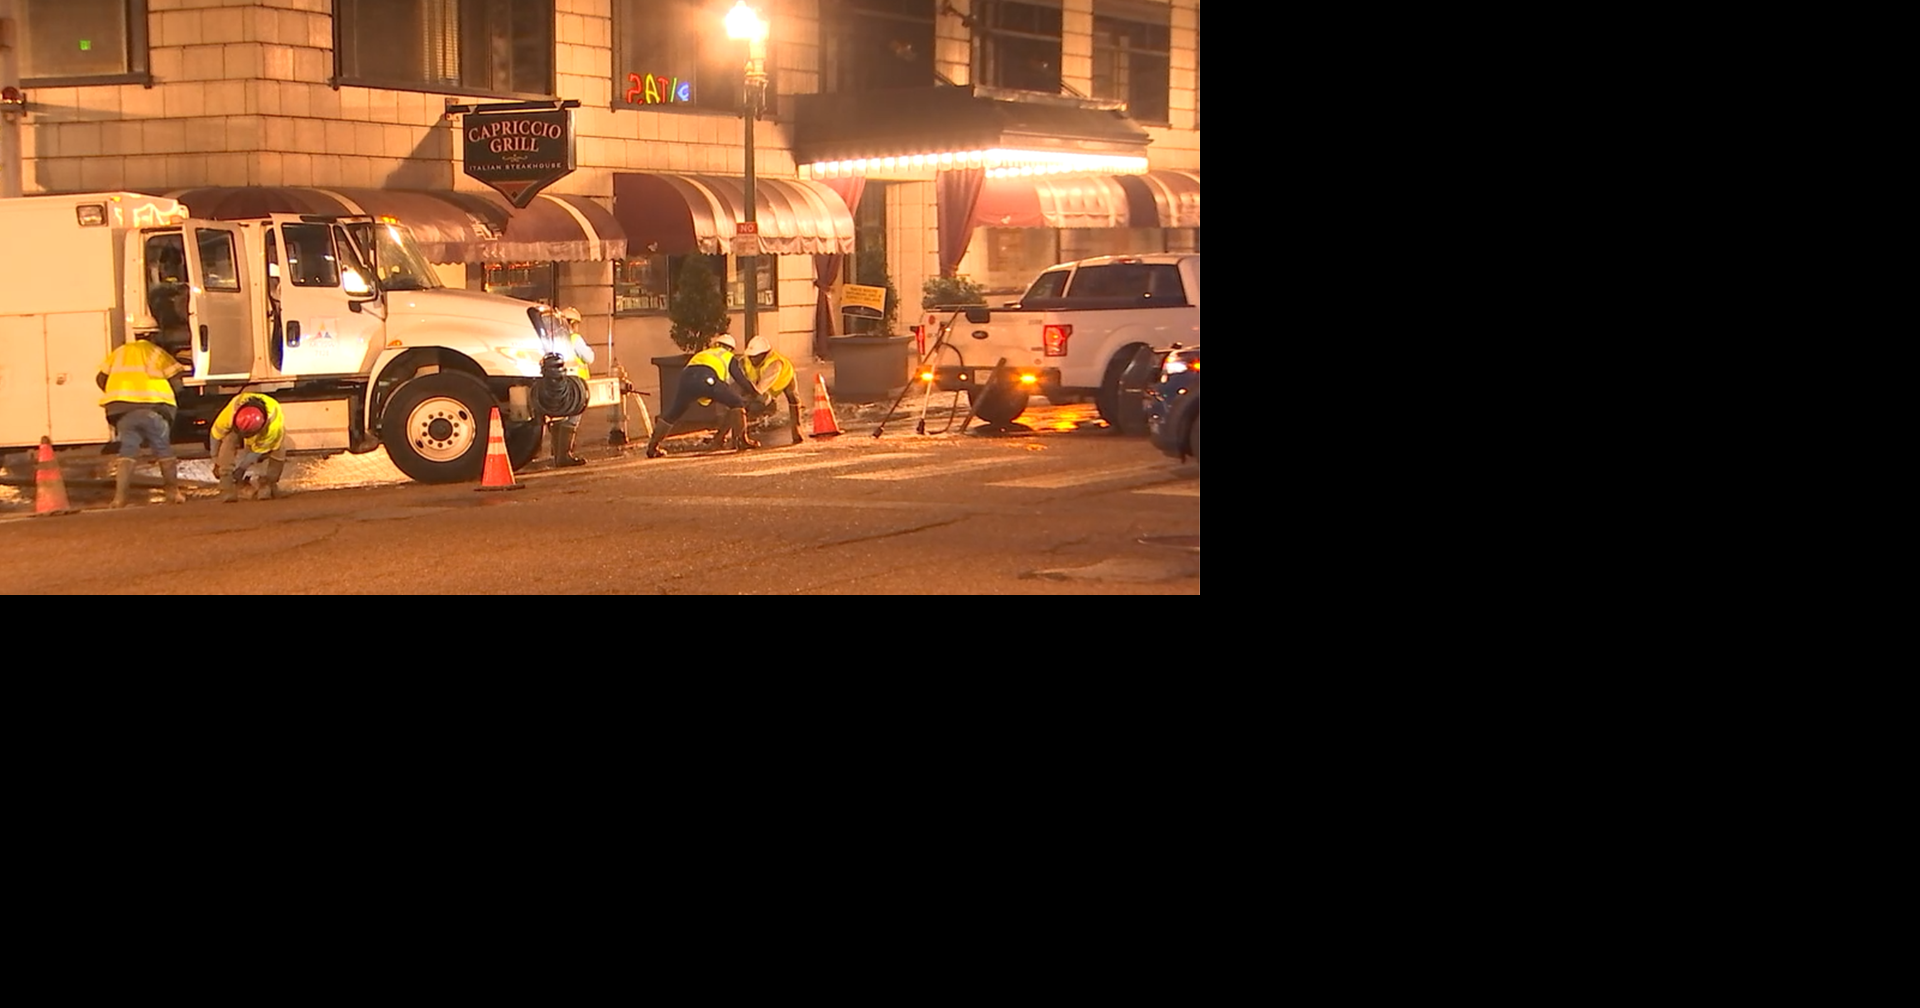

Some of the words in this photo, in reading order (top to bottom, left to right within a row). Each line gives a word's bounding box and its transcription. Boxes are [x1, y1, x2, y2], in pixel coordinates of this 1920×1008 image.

[468, 120, 562, 143] CAPRICCIO
[490, 136, 539, 153] GRILL
[505, 162, 562, 170] STEAKHOUSE
[740, 224, 754, 233] NO
